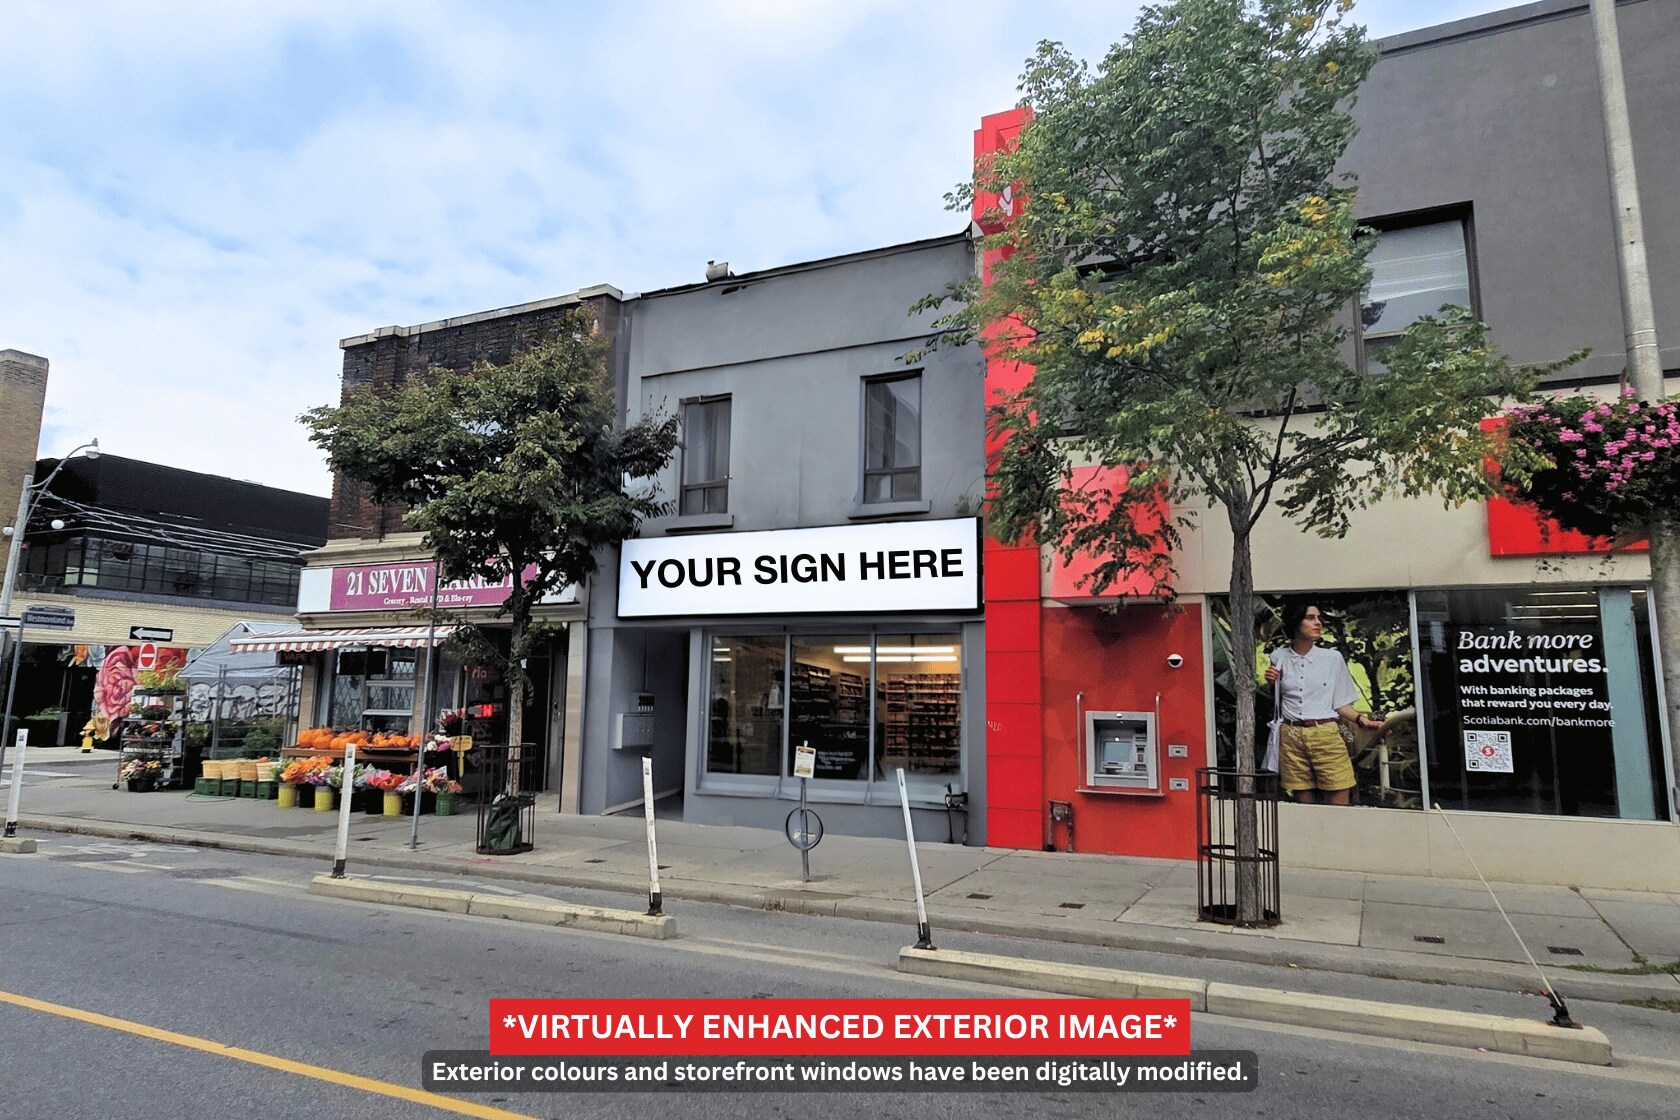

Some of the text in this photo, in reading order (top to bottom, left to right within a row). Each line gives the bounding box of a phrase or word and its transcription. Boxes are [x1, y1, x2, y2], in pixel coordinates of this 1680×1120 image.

[631, 548, 964, 588] YOUR SIGN HERE
[346, 571, 363, 596] 21
[367, 567, 430, 595] SEVEN
[1457, 630, 1594, 650] Bank more
[1459, 654, 1609, 673] adventures.
[1460, 685, 1594, 697] With banking packages
[1461, 698, 1614, 711] that reward you every day.
[1463, 715, 1616, 728] Scotiabank.com/bankmore
